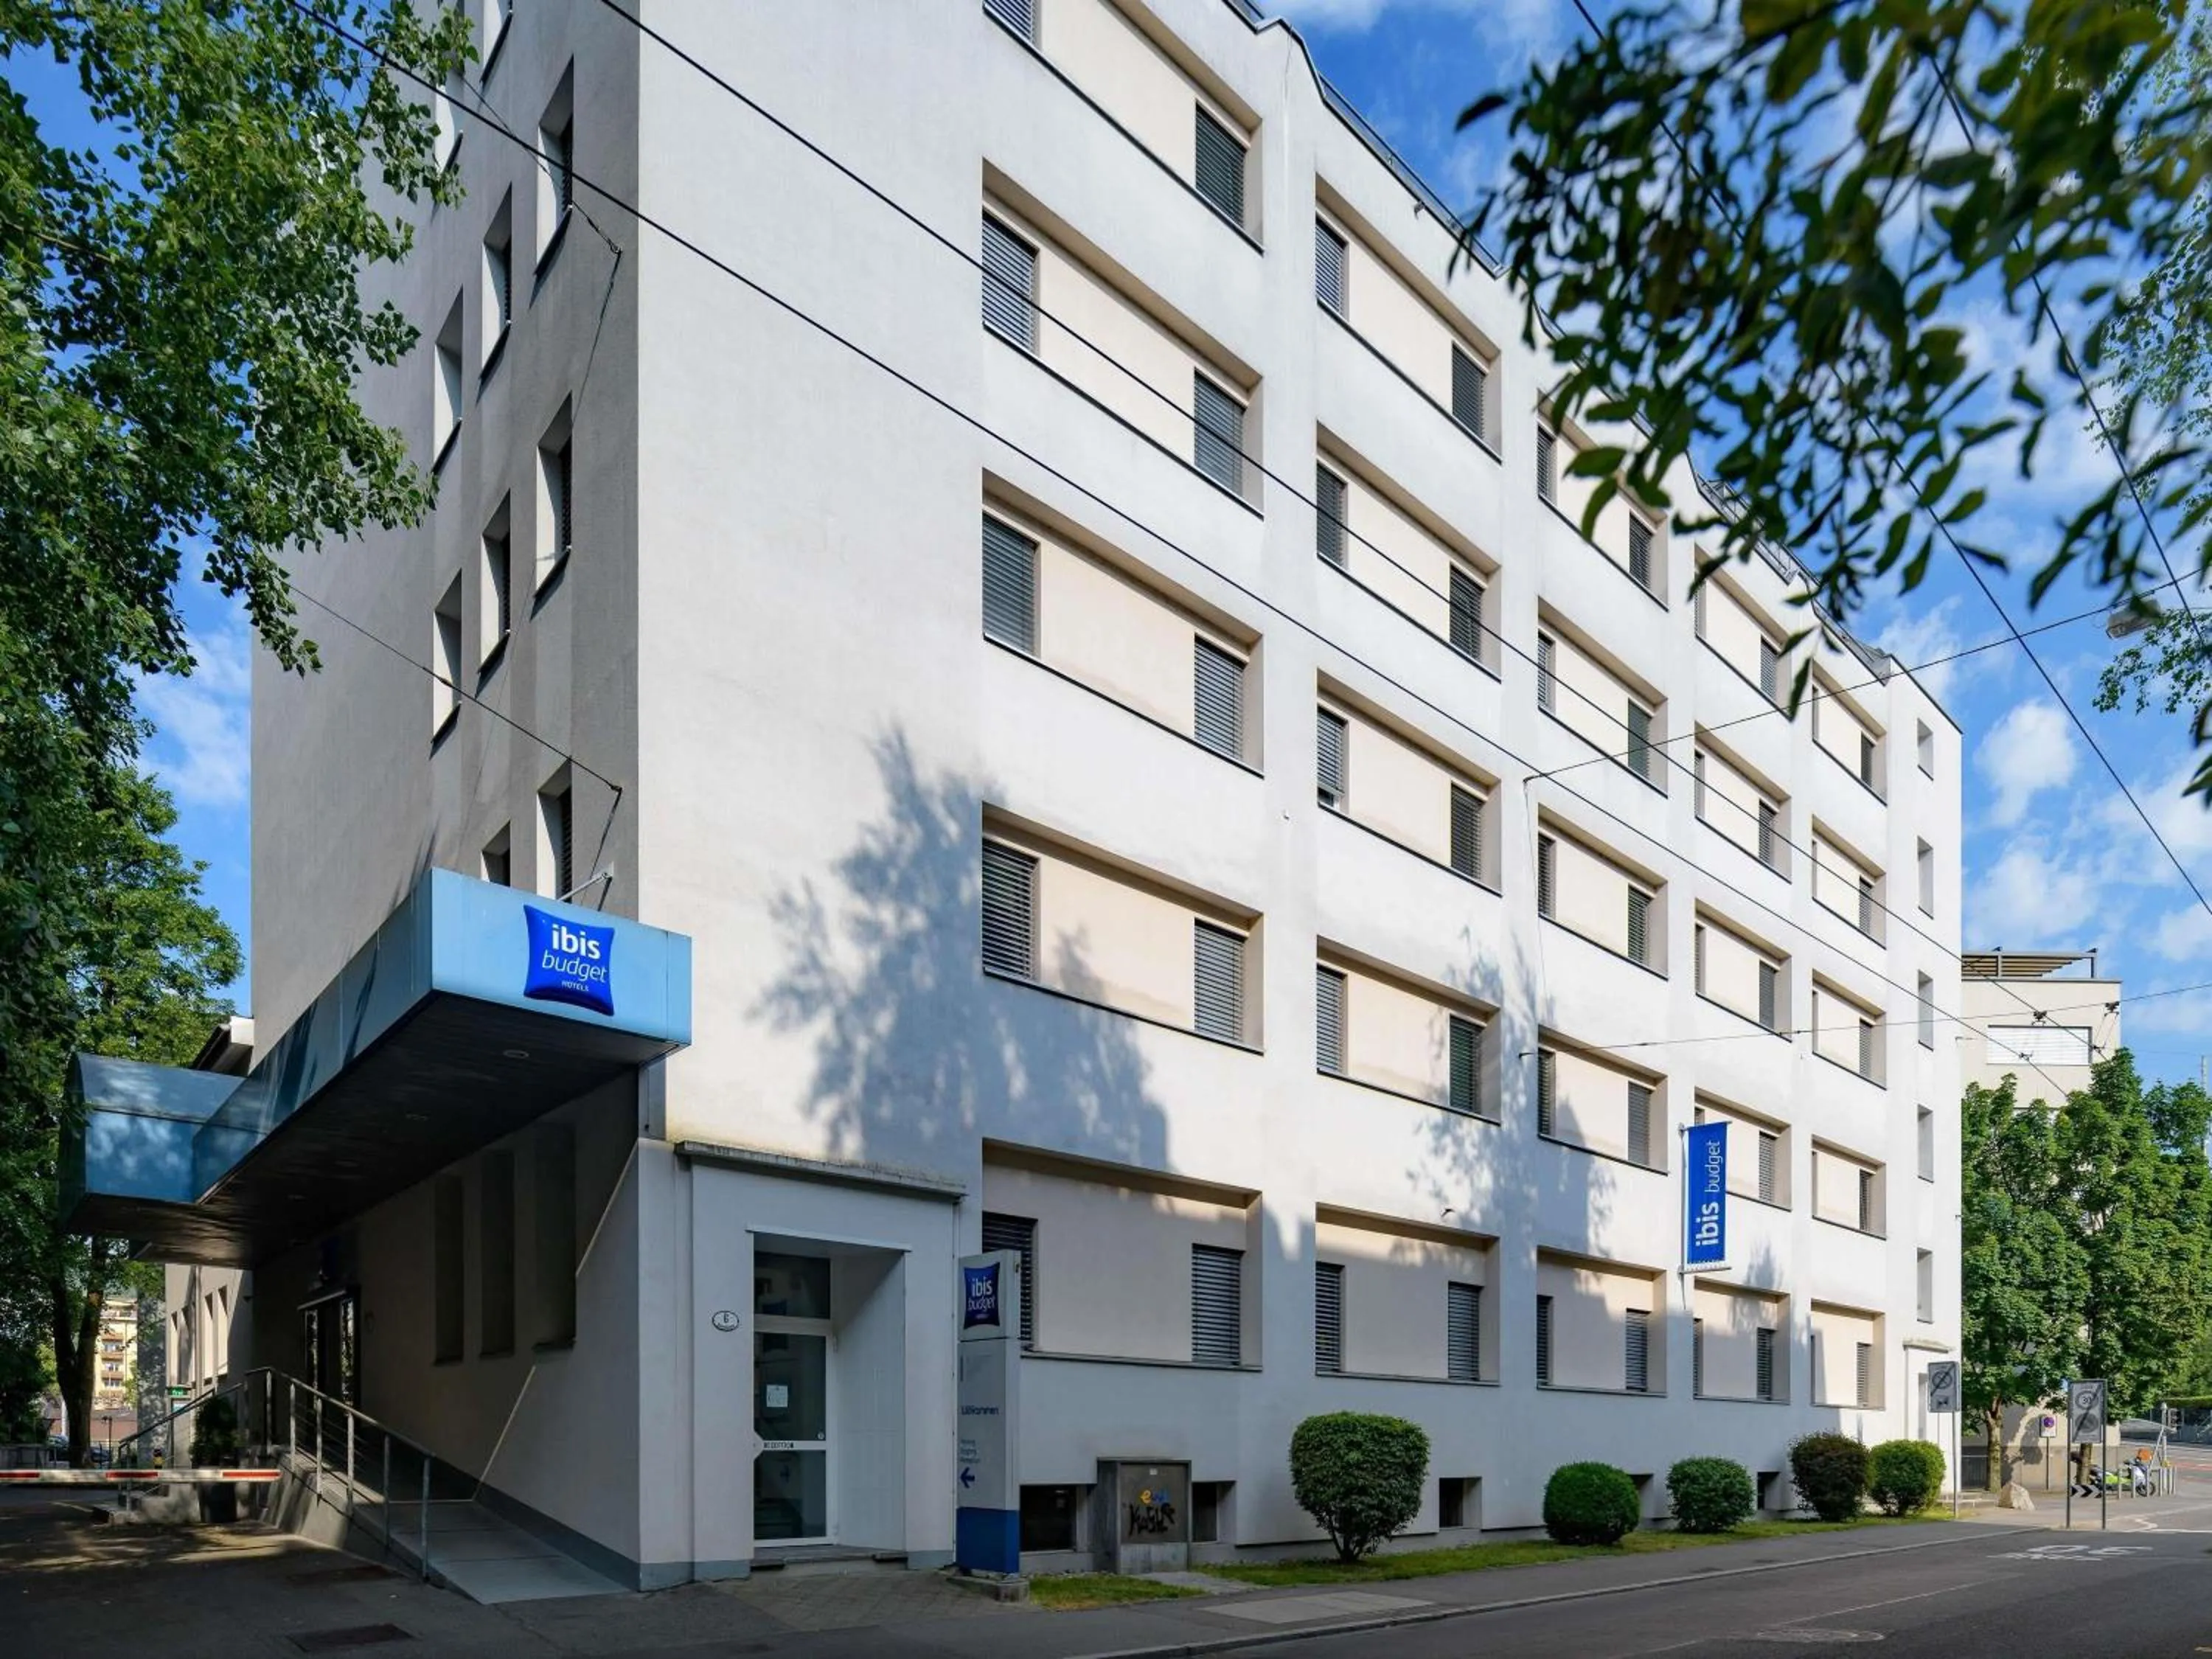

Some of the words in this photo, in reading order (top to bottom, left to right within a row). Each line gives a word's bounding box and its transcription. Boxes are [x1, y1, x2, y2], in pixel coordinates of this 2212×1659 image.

[552, 923, 601, 959] ibis
[542, 949, 608, 983] budget
[1705, 1141, 1722, 1192] budget
[1695, 1201, 1719, 1247] ibis
[967, 1295, 995, 1312] budget
[971, 1276, 993, 1297] ibis
